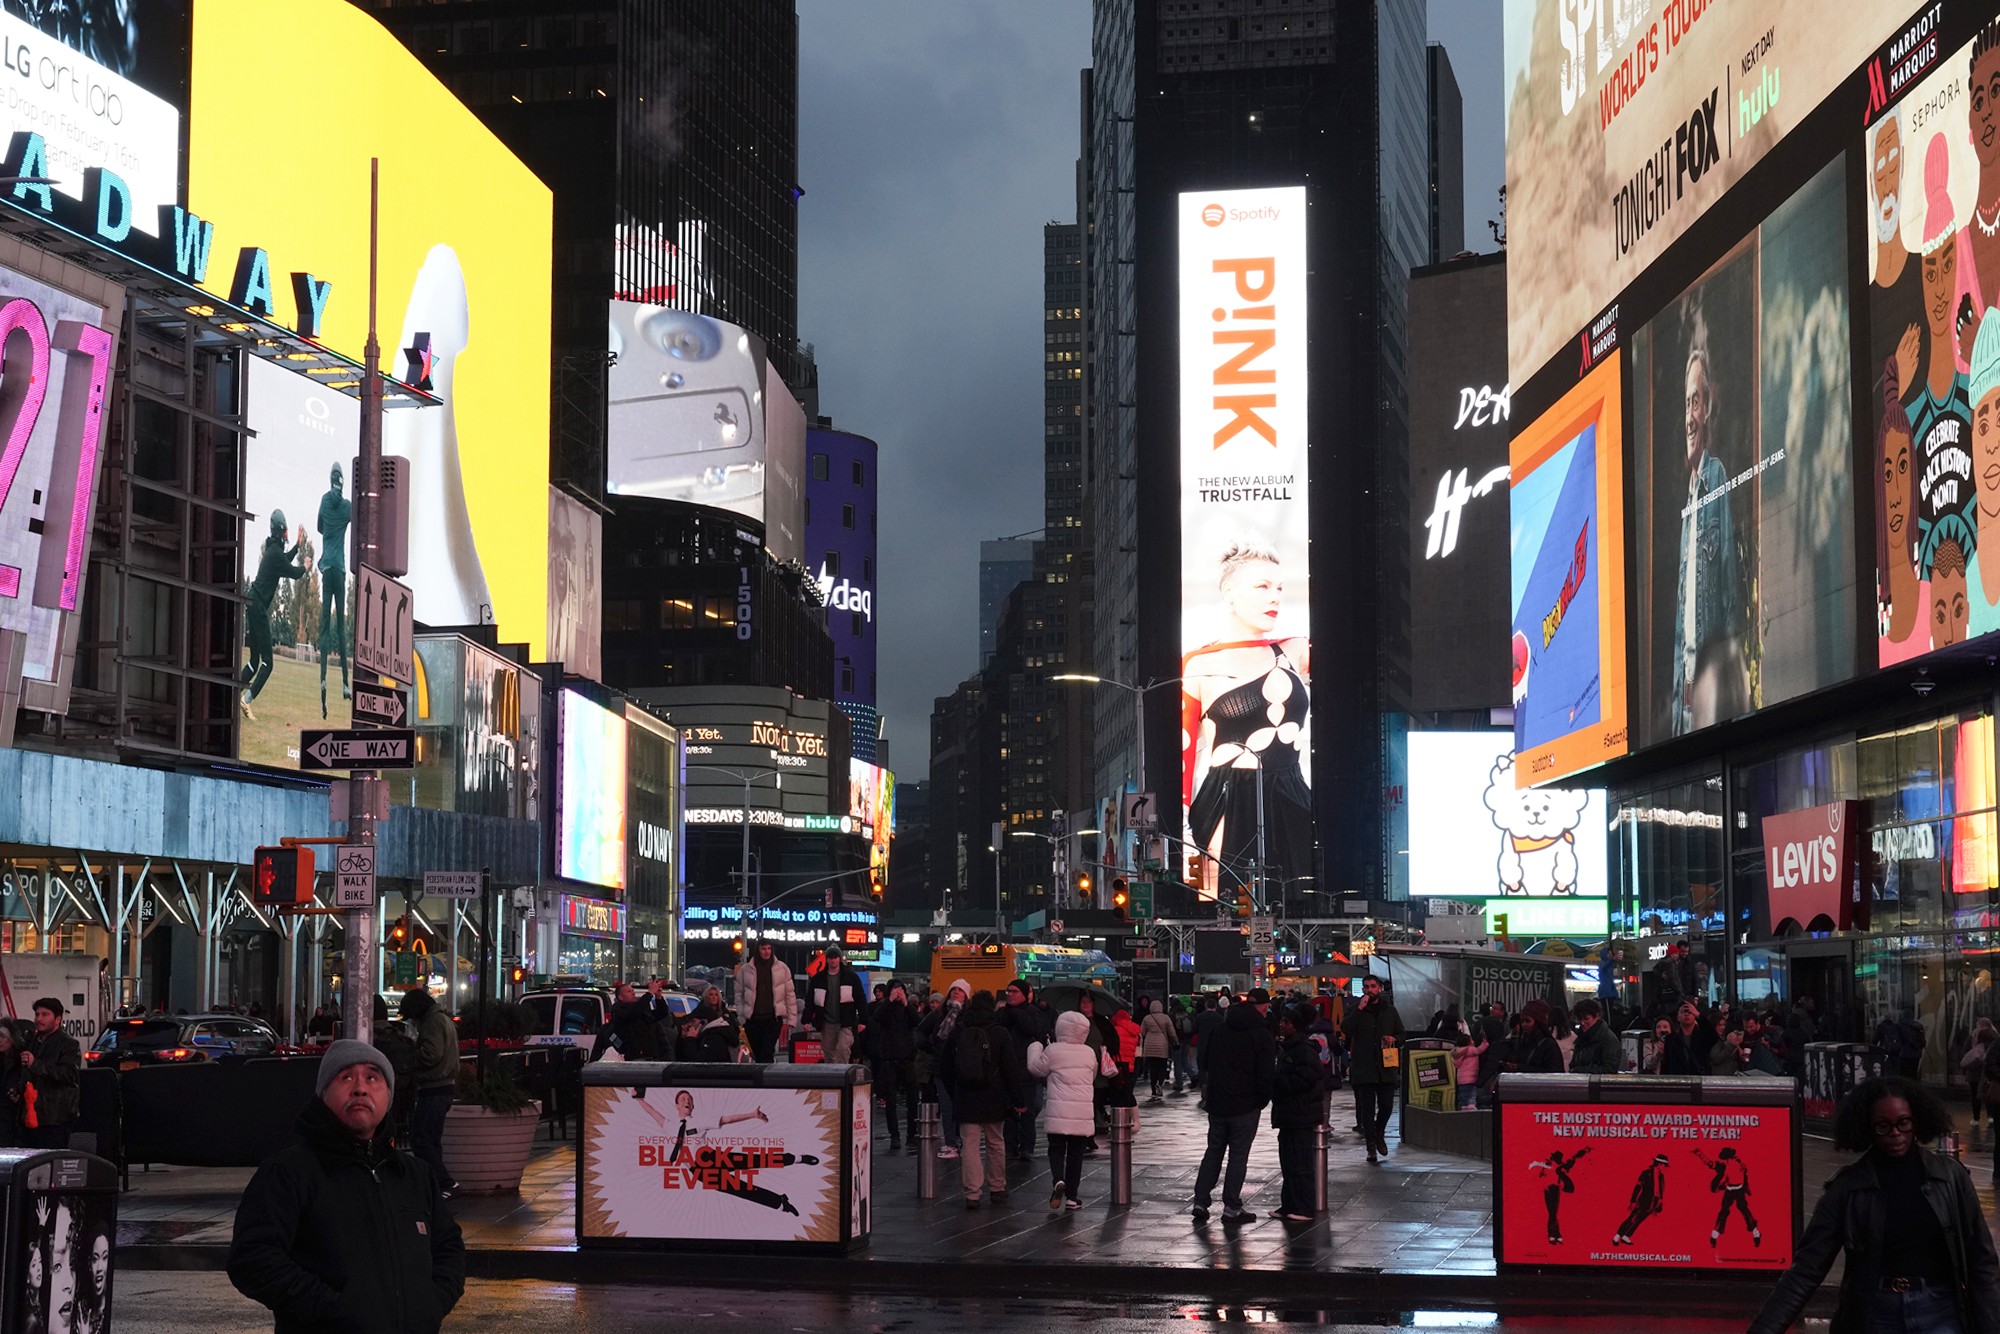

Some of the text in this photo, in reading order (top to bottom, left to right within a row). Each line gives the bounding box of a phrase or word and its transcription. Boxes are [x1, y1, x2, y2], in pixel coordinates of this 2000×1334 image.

[1889, 3, 1942, 66] MARRIOTT
[5, 35, 31, 78] LG
[1741, 25, 1775, 78] NEXT DAY
[1600, 22, 1658, 132] WORLD'S
[1889, 37, 1938, 95] MARQUIS
[1739, 64, 1780, 139] hulu
[1912, 78, 1962, 133] SEPHORA
[1612, 87, 1719, 262] TONIGHT FOX
[1230, 205, 1280, 221] Spotify
[1592, 304, 1619, 340] MARRIOTT
[1212, 257, 1277, 451] P!NK
[1592, 327, 1616, 359] MARQUIS
[299, 413, 336, 437] OAKLEY
[1926, 419, 1960, 457] CELEBRATE
[1198, 475, 1294, 487] THE NEW ALBUM
[1731, 477, 1738, 489] BE
[1738, 467, 1753, 485] BURIED
[1920, 447, 1971, 501] BLACK HISTORY
[1199, 487, 1292, 502] TRUSTFALL
[1932, 479, 1959, 516] MONTH
[737, 567, 751, 640] 1500
[359, 643, 373, 662] ONLY
[376, 651, 389, 670] ONLY
[393, 658, 410, 678] ONLY
[360, 694, 400, 716] ONE WAY
[695, 728, 724, 740] Yet.
[317, 740, 400, 758] ONE WAY
[806, 815, 839, 829] hulu
[638, 820, 673, 864] OLD NAVY
[343, 876, 367, 886] WALK
[465, 875, 477, 884] ZONE
[345, 890, 365, 900] BIKE
[587, 904, 608, 932] GIFTS
[793, 911, 805, 922] to
[808, 910, 821, 922] 60
[1517, 908, 1567, 927] LINE
[1254, 932, 1272, 943] 25
[1533, 1112, 1760, 1126] THE MOST TONY AWARD-WINNING
[638, 1136, 785, 1147] EVERYONE'S INVITED TO THIS
[1553, 1125, 1741, 1140] NEW MUSICAL OF THE YEAR!
[638, 1145, 785, 1169] BLACK-TIE
[1590, 1252, 1691, 1263] MJTHEMUSICAL.COM
